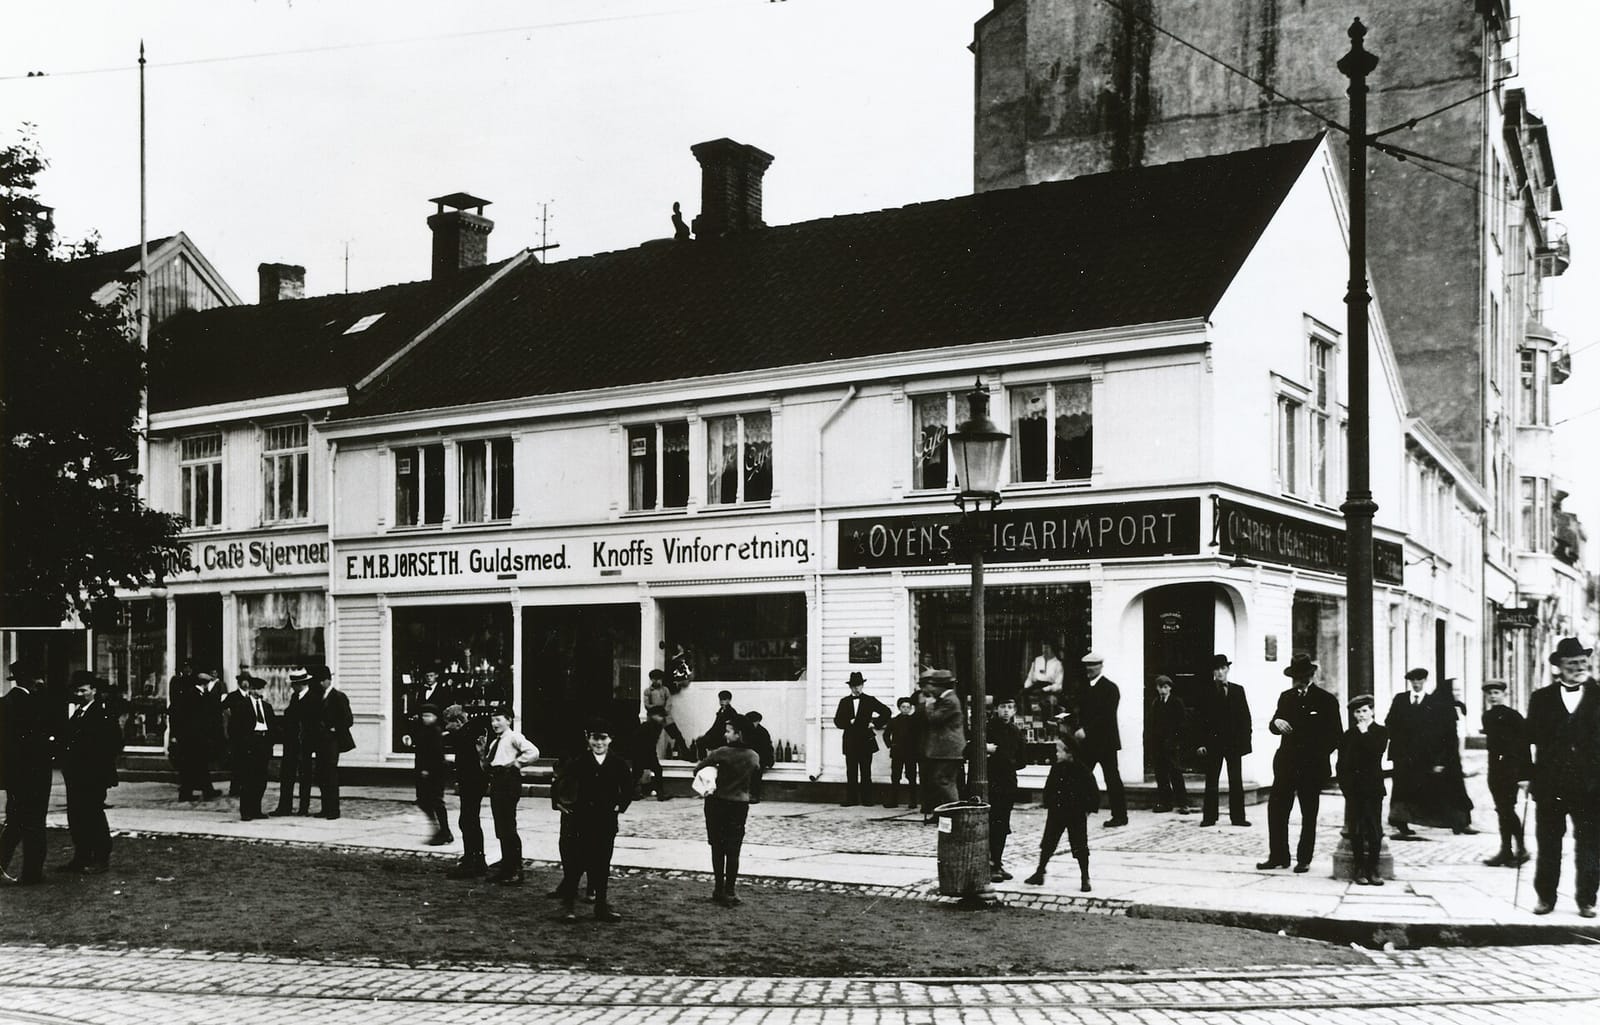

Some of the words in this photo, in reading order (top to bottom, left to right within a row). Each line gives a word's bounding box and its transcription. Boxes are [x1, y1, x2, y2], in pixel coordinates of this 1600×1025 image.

[593, 539, 653, 567] Knoffs
[662, 532, 815, 564] Vinforretning.
[990, 512, 1177, 554] IGARIMPORT
[204, 543, 244, 571] Café
[249, 539, 329, 574] Stjernen
[469, 544, 571, 573] Guldsmed.
